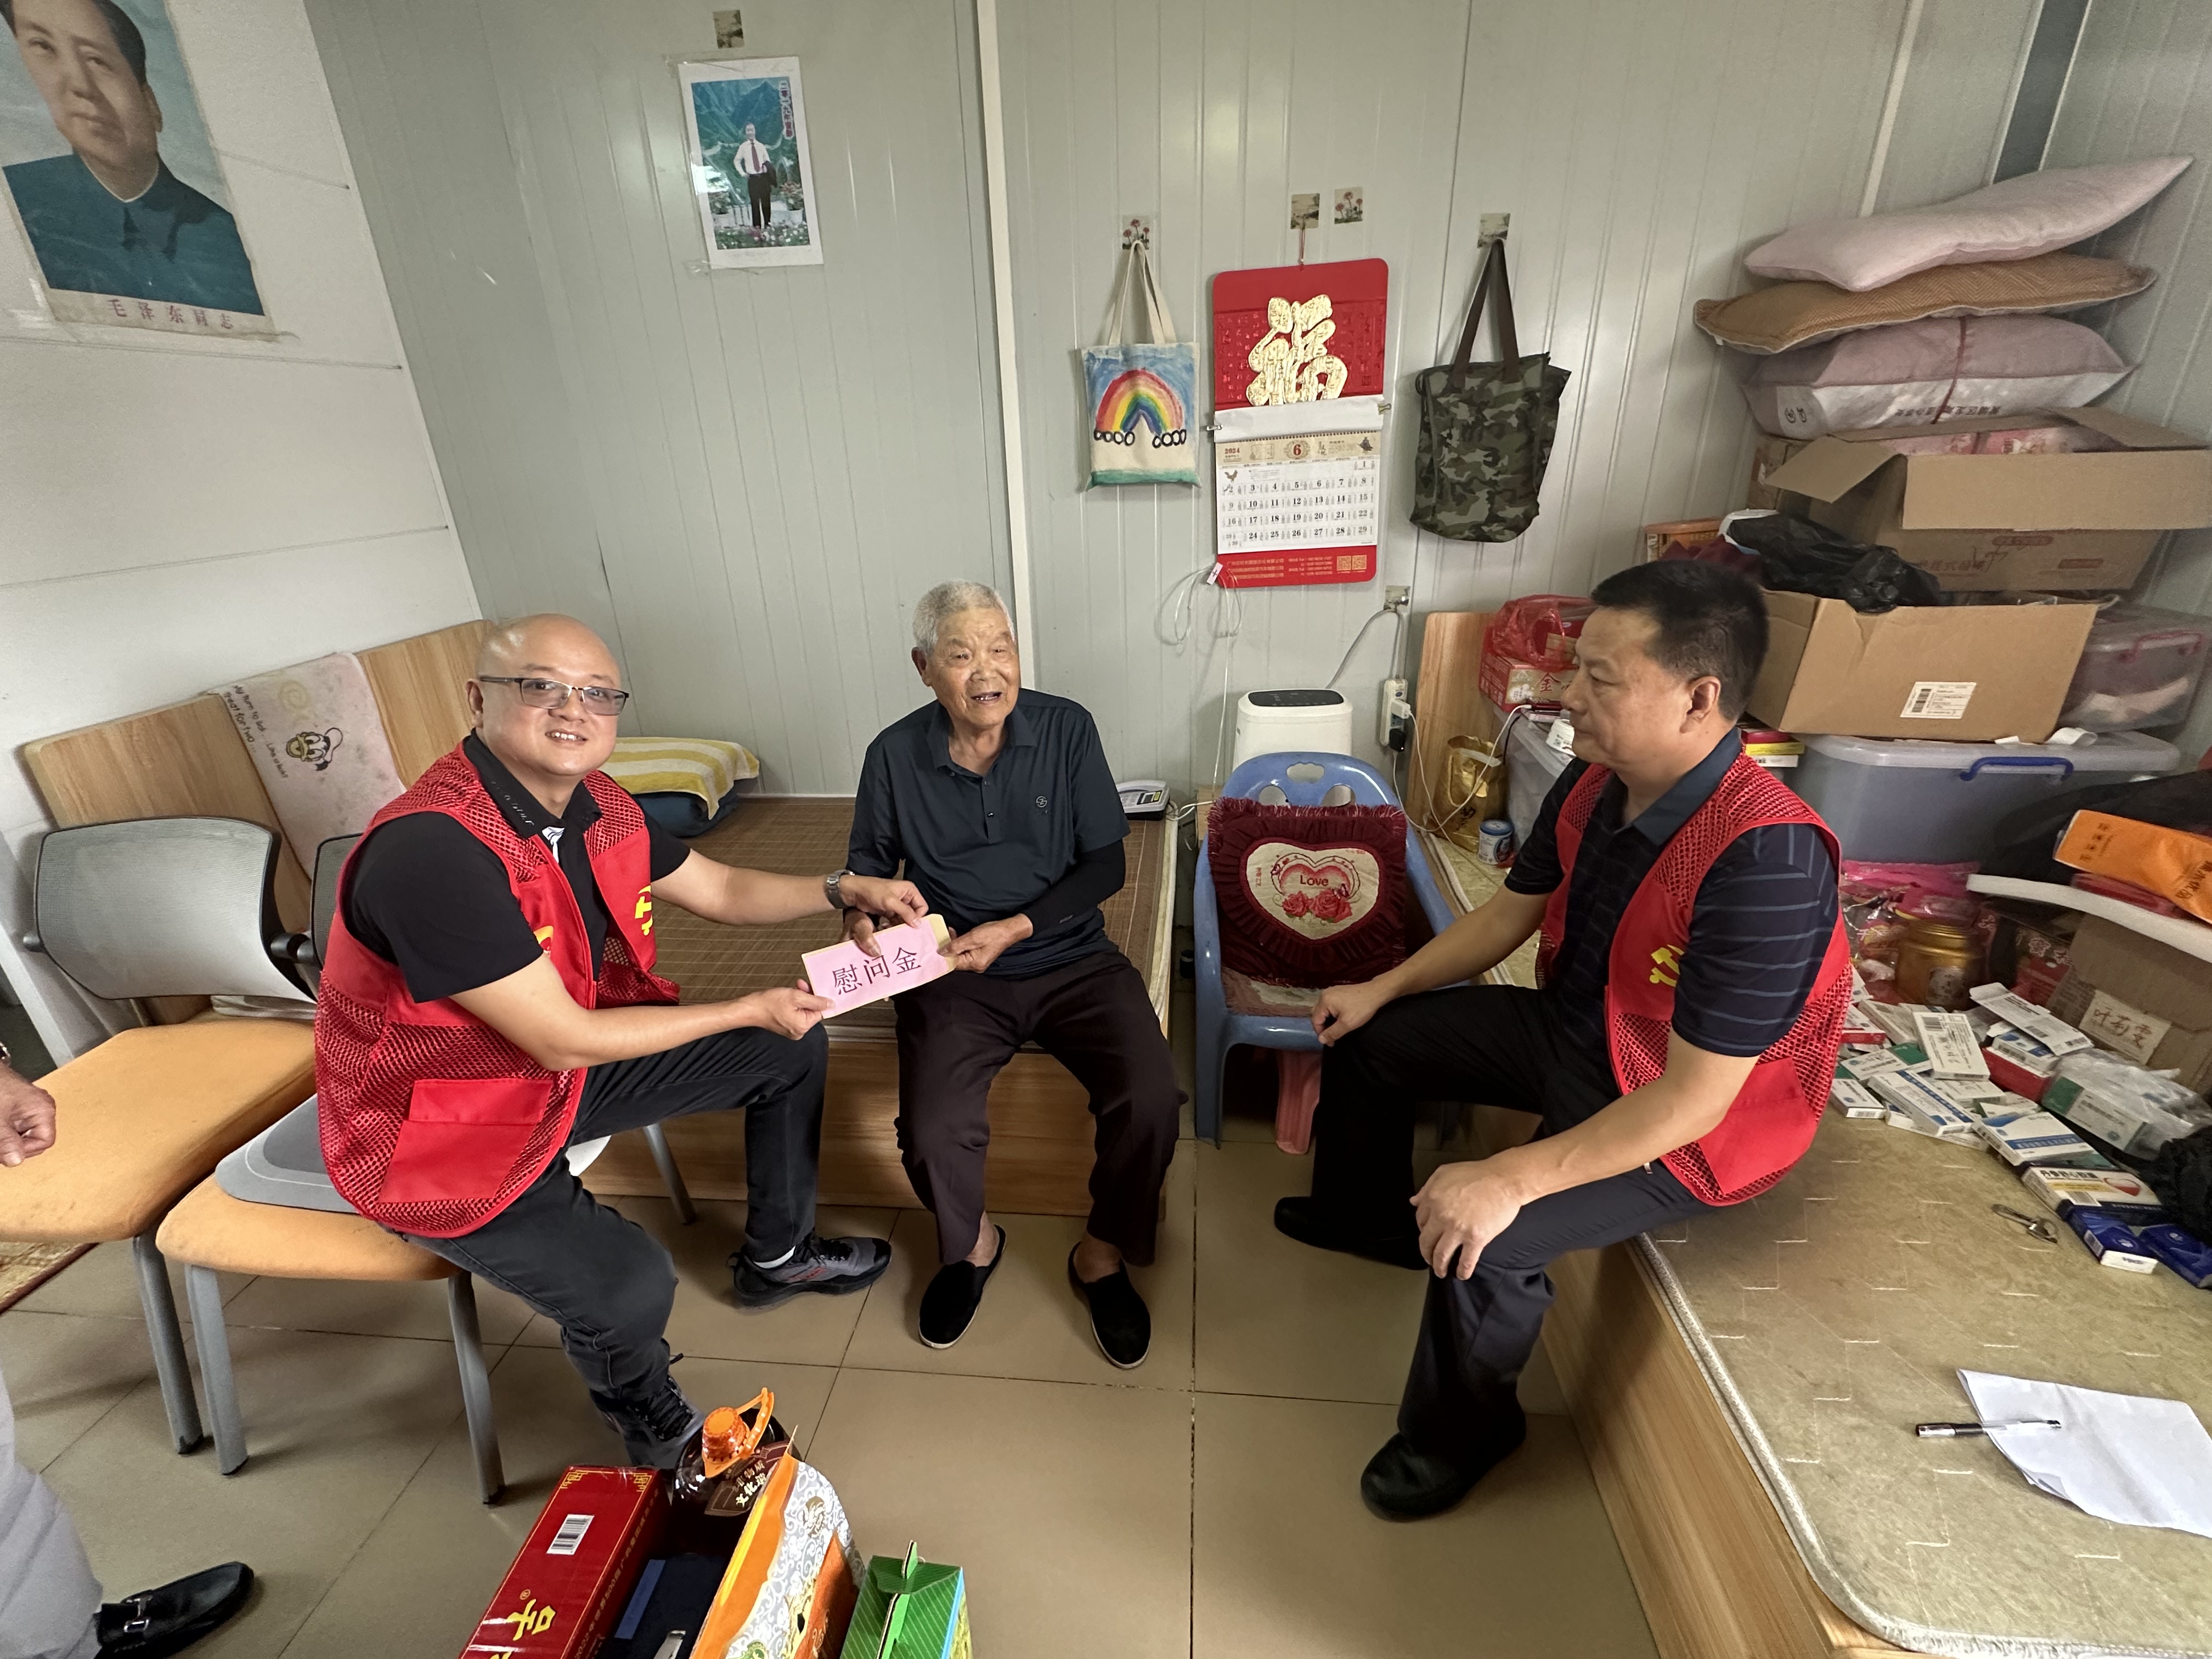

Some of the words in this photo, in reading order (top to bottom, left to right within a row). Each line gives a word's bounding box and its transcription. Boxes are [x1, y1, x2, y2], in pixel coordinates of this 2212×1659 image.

[106, 298, 234, 329] 毛泽东同志
[1246, 294, 1347, 406] 福
[1293, 444, 1301, 456] 6
[1537, 671, 1572, 692] 金
[1300, 874, 1329, 886] Love
[832, 946, 922, 995] 慰问金
[735, 1460, 765, 1487] 非物质
